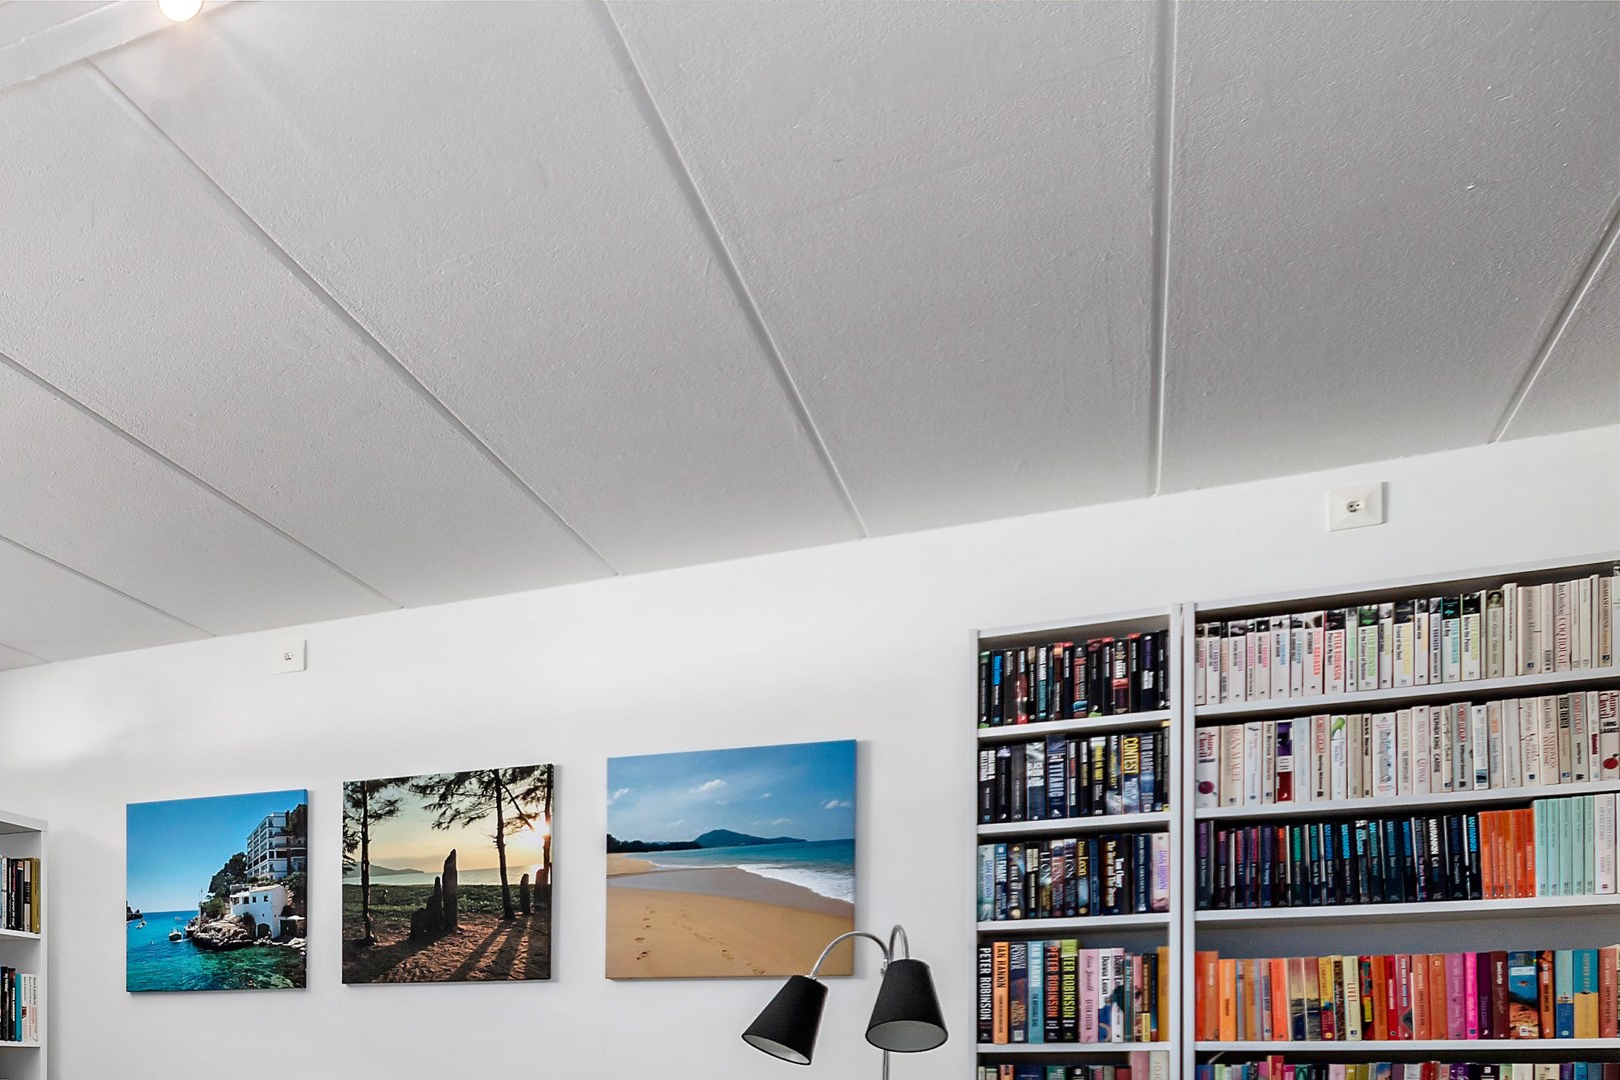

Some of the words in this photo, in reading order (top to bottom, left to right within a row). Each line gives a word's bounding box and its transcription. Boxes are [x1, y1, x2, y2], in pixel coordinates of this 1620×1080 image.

[1555, 618, 1565, 637] COQ
[1334, 632, 1342, 649] PETER
[1557, 638, 1567, 667] ROUGE
[1334, 650, 1343, 680] ROBINSON
[1599, 693, 1609, 719] Clavell
[1609, 693, 1618, 718] James
[1123, 738, 1139, 774] CONTEST
[1049, 763, 1063, 797] TITANIC
[985, 860, 993, 873] DAN
[1078, 856, 1088, 876] Leon
[1116, 858, 1124, 869] Tom
[1158, 850, 1167, 863] DAN
[985, 874, 993, 898] BROWN
[1158, 865, 1167, 890] BROWN
[980, 948, 991, 974] PETER
[997, 946, 1006, 958] IAN
[1031, 944, 1040, 957] IAN
[1047, 946, 1058, 971] PETER
[996, 961, 1006, 988] RANKIN
[1030, 959, 1041, 987] RANKIN
[1101, 956, 1110, 976] Donna
[979, 977, 991, 1020] ROBINSON
[1047, 975, 1059, 1017] ROBINSON
[1063, 975, 1075, 1018] ROBINSON
[1101, 978, 1110, 995] Leon
